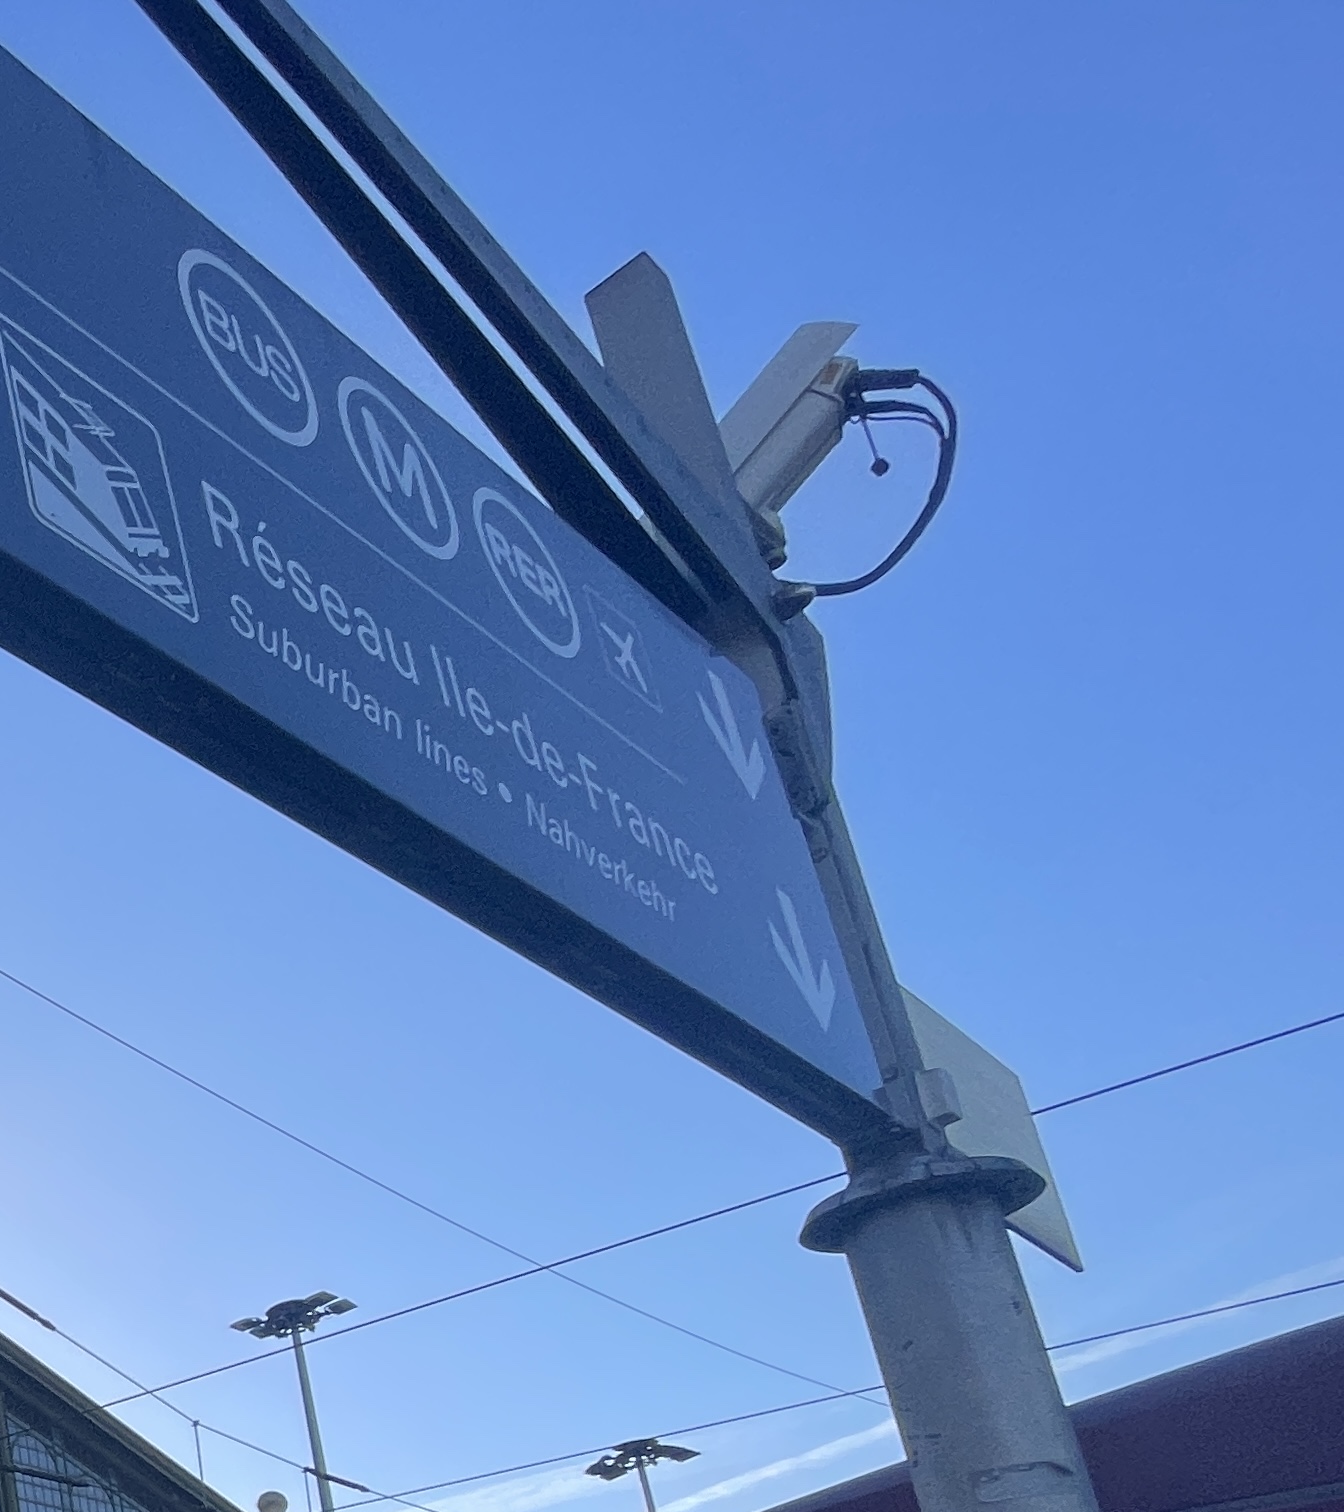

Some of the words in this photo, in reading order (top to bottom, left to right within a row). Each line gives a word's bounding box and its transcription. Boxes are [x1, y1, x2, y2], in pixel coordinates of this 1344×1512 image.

[197, 288, 301, 403] BUS
[360, 405, 438, 530] M
[483, 521, 567, 617] RER
[200, 480, 421, 686] Réseau
[429, 643, 719, 895] Ile-de-France
[229, 593, 403, 740] Suburban
[415, 717, 489, 796] lines
[523, 792, 677, 923] Nahverkehr
